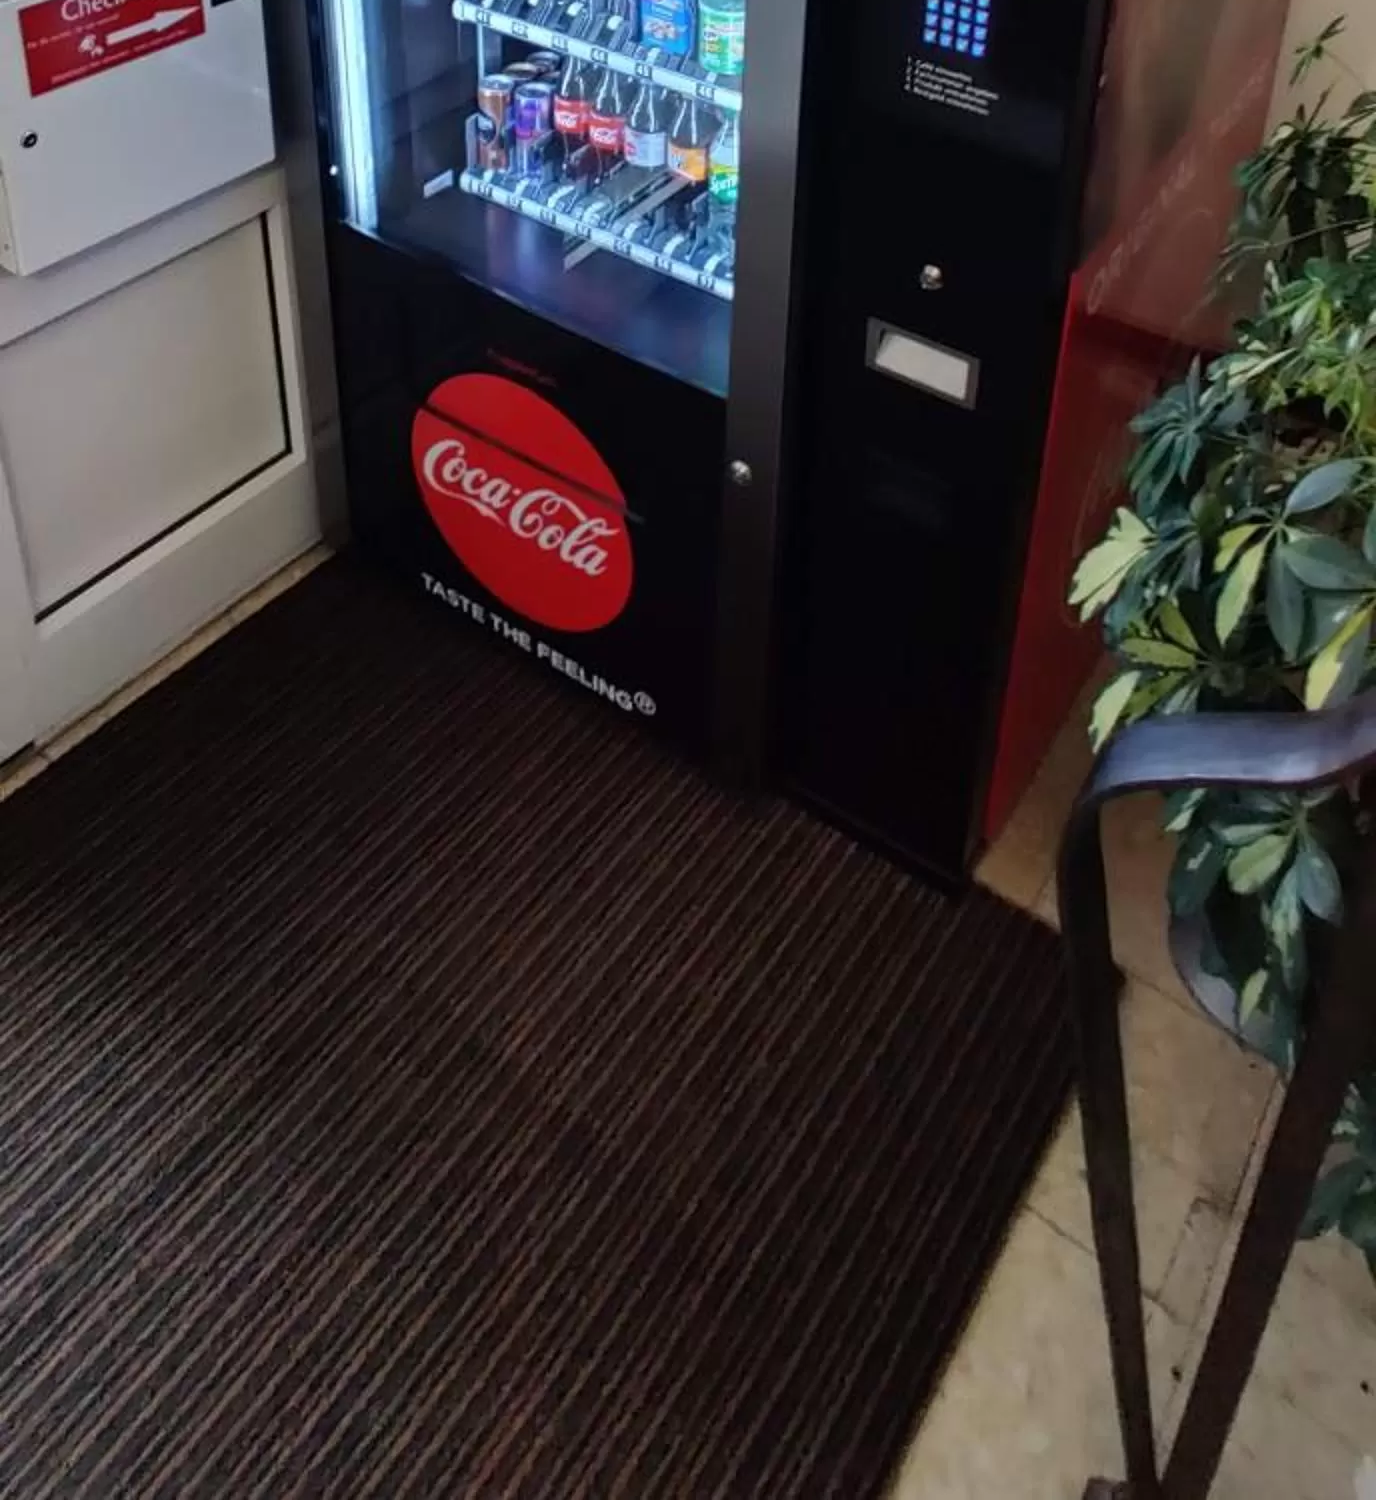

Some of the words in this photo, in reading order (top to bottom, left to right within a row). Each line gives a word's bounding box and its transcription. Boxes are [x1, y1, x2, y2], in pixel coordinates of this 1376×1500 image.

[422, 439, 620, 577] Coca-Cola
[420, 572, 485, 624] TASTE
[489, 611, 531, 652] THE
